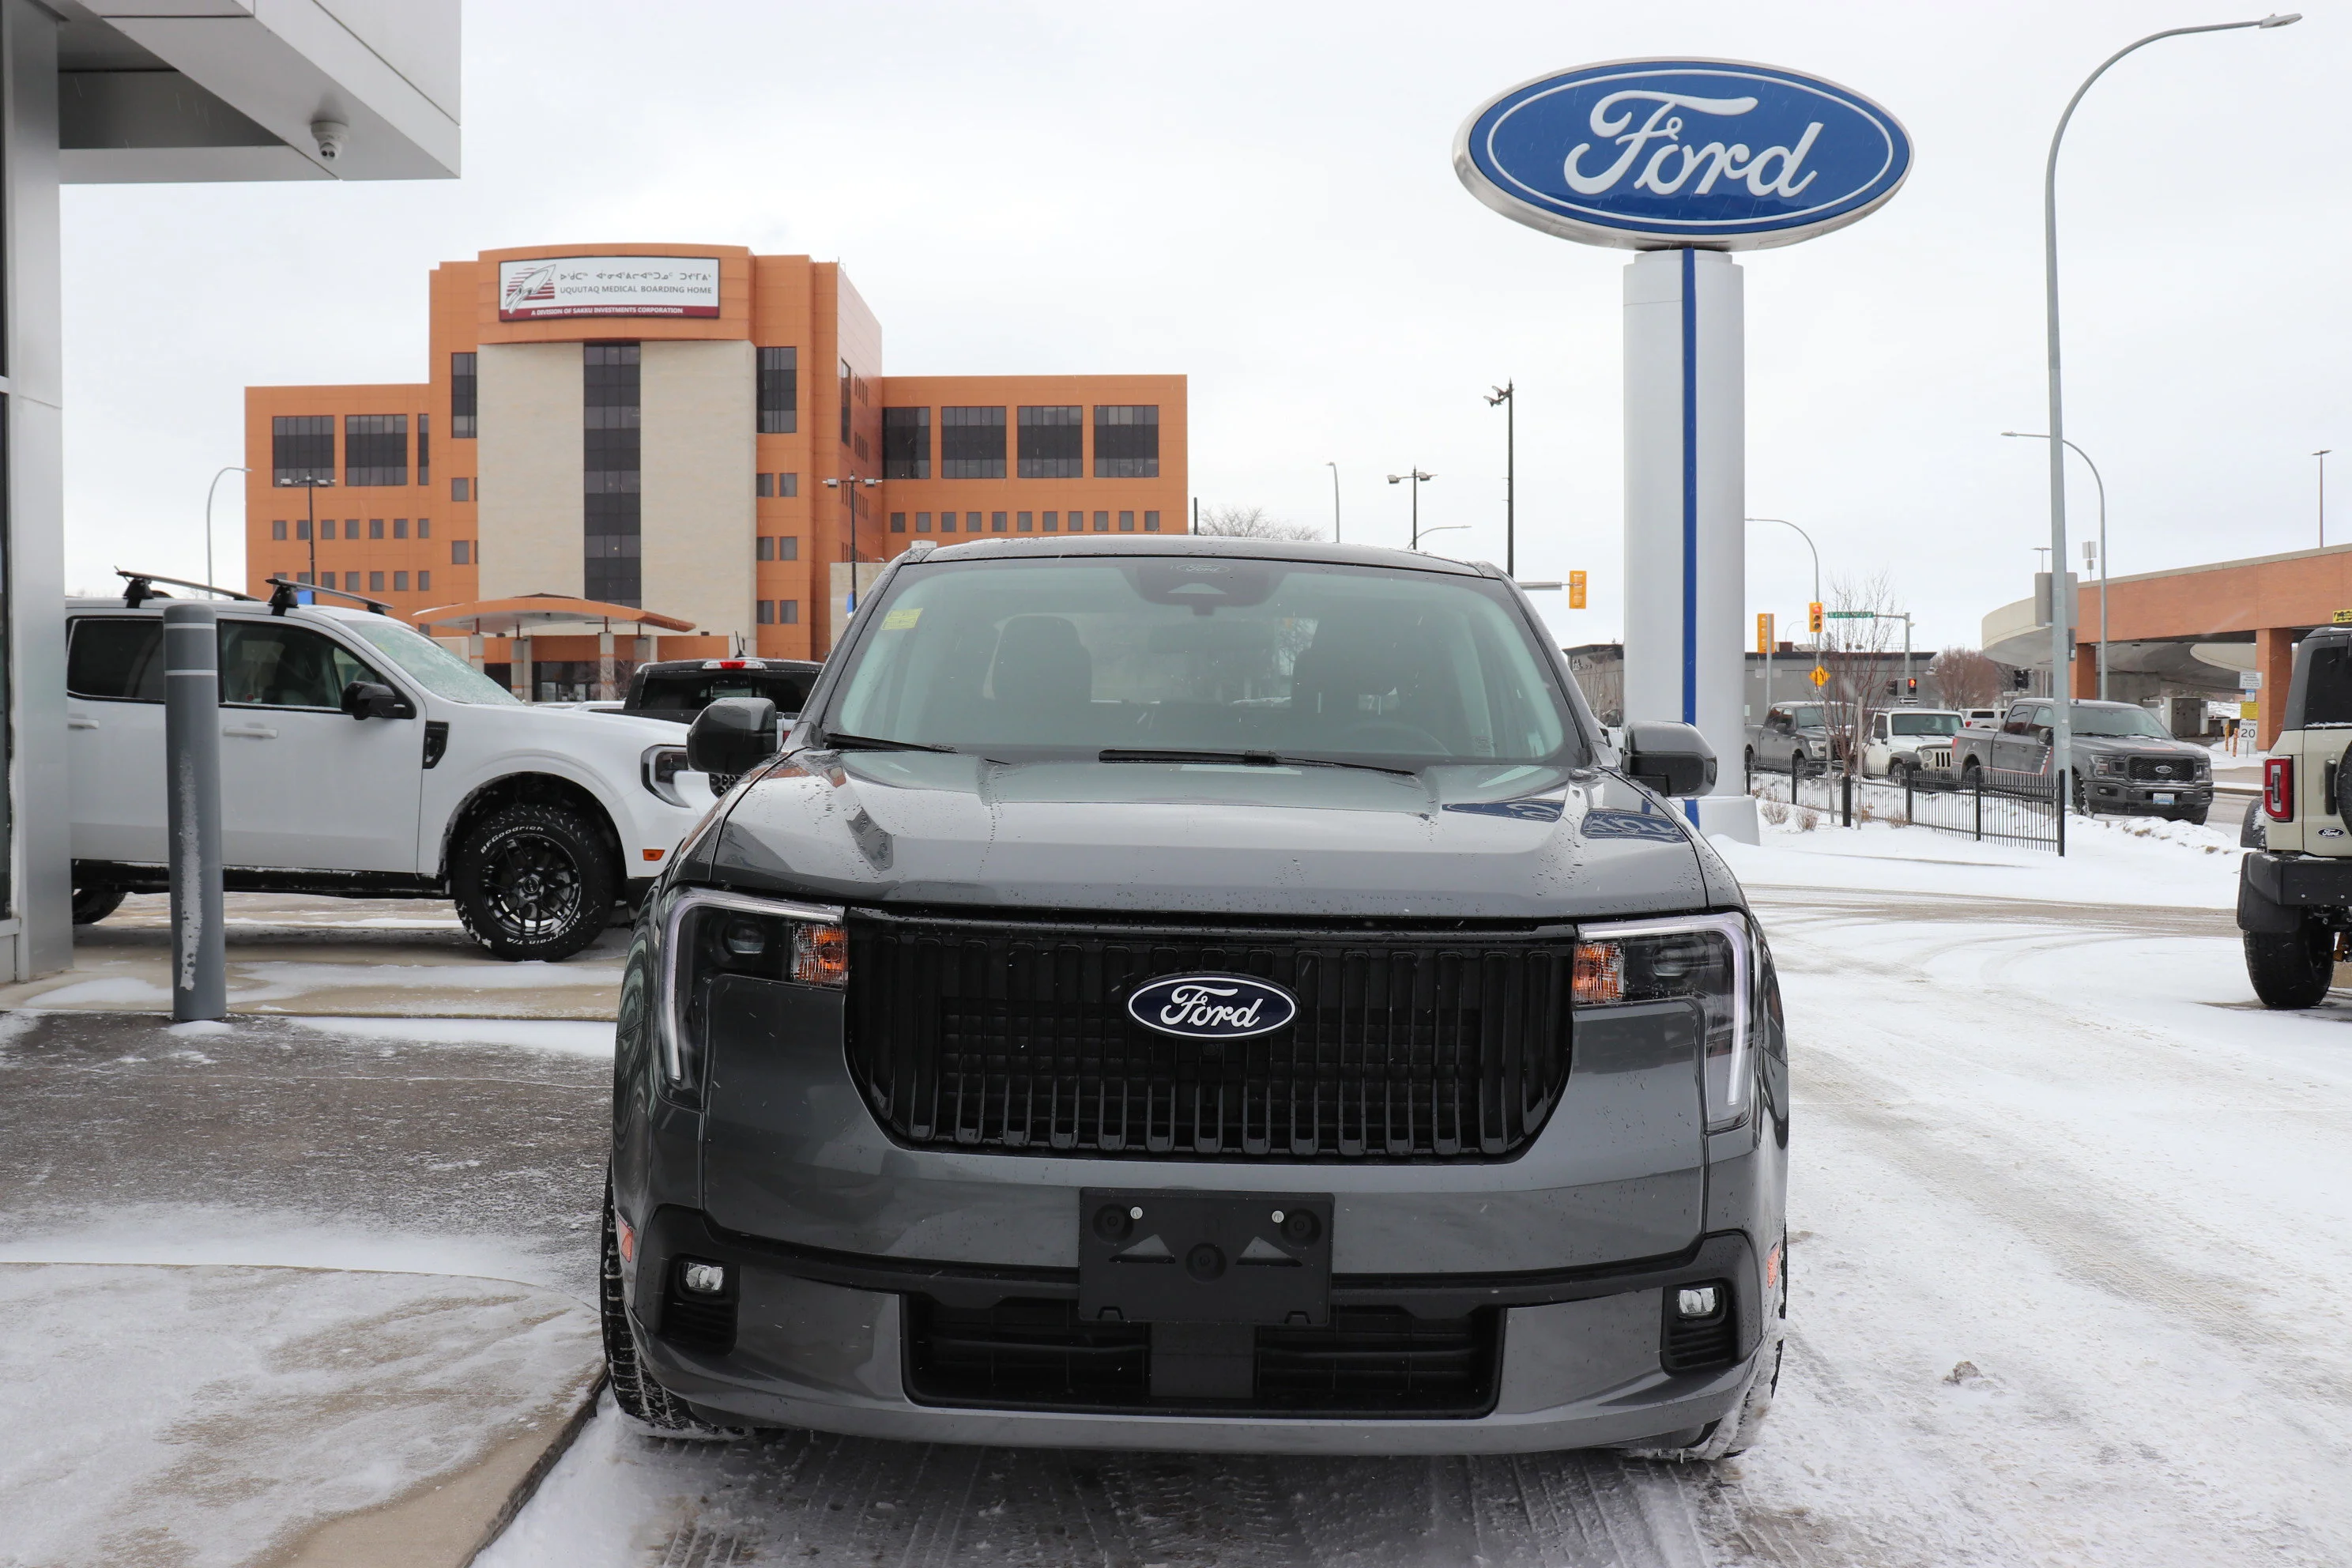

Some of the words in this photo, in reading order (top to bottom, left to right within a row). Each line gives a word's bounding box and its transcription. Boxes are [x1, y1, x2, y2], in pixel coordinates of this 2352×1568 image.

[1564, 90, 1823, 198] Ford
[560, 286, 600, 295] UQUUTAQ
[601, 285, 637, 293] MEDICAL
[641, 285, 684, 294] BOARDING
[2241, 729, 2256, 738] 20
[481, 825, 544, 854] BFGoodrich
[1160, 985, 1264, 1027] Ford
